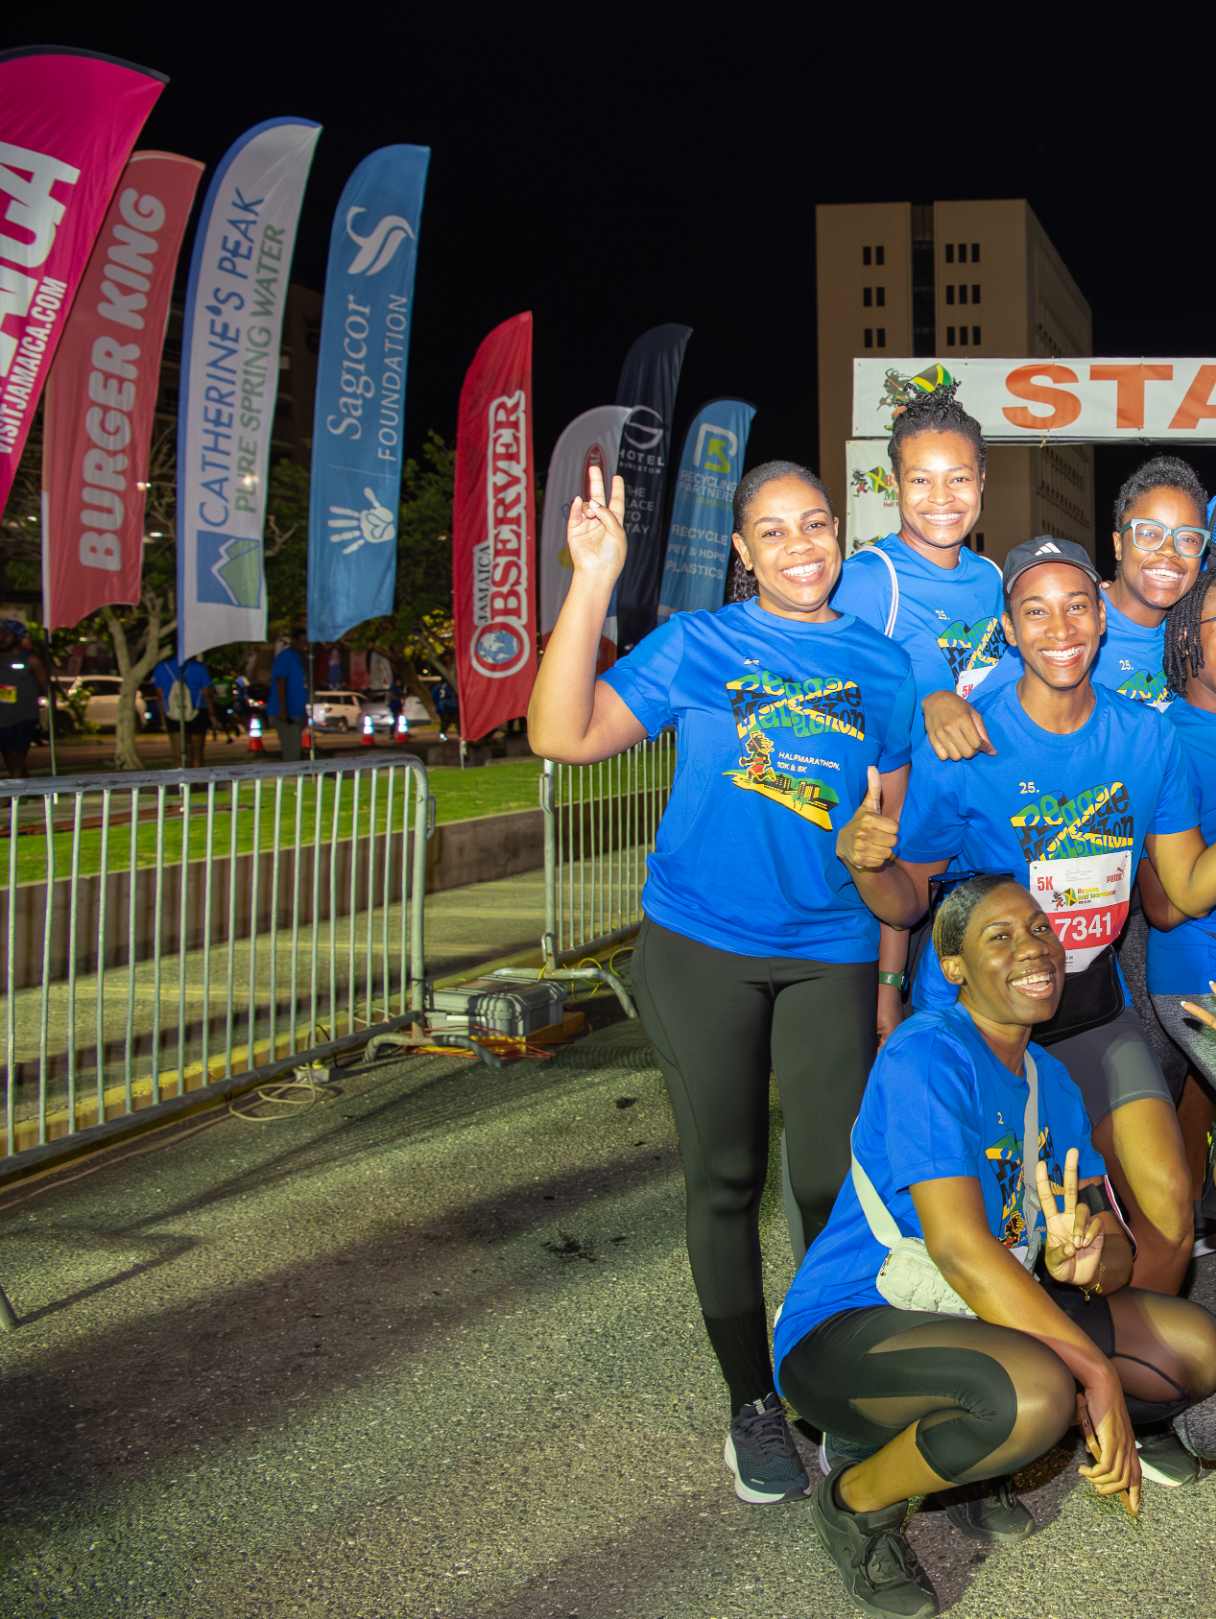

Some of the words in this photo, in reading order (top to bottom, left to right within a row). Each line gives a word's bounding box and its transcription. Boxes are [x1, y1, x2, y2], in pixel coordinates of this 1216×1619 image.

[98, 188, 166, 330] KING
[219, 187, 264, 281] PEAK
[250, 224, 285, 318] WATER
[198, 287, 245, 528] CATHERINE'S
[239, 325, 271, 432] SPRING
[327, 294, 375, 441] Sagicor
[377, 294, 408, 462] FOUNDATION
[80, 336, 141, 572] BURGER
[235, 436, 259, 513] PURE
[624, 523, 650, 535] TAY
[625, 499, 656, 512] LACE
[671, 524, 728, 545] RECYCLE
[477, 544, 491, 623] JAMAICA
[1018, 781, 1041, 795] 25.
[1036, 876, 1054, 892] 5K
[1054, 911, 1113, 943] 7341
